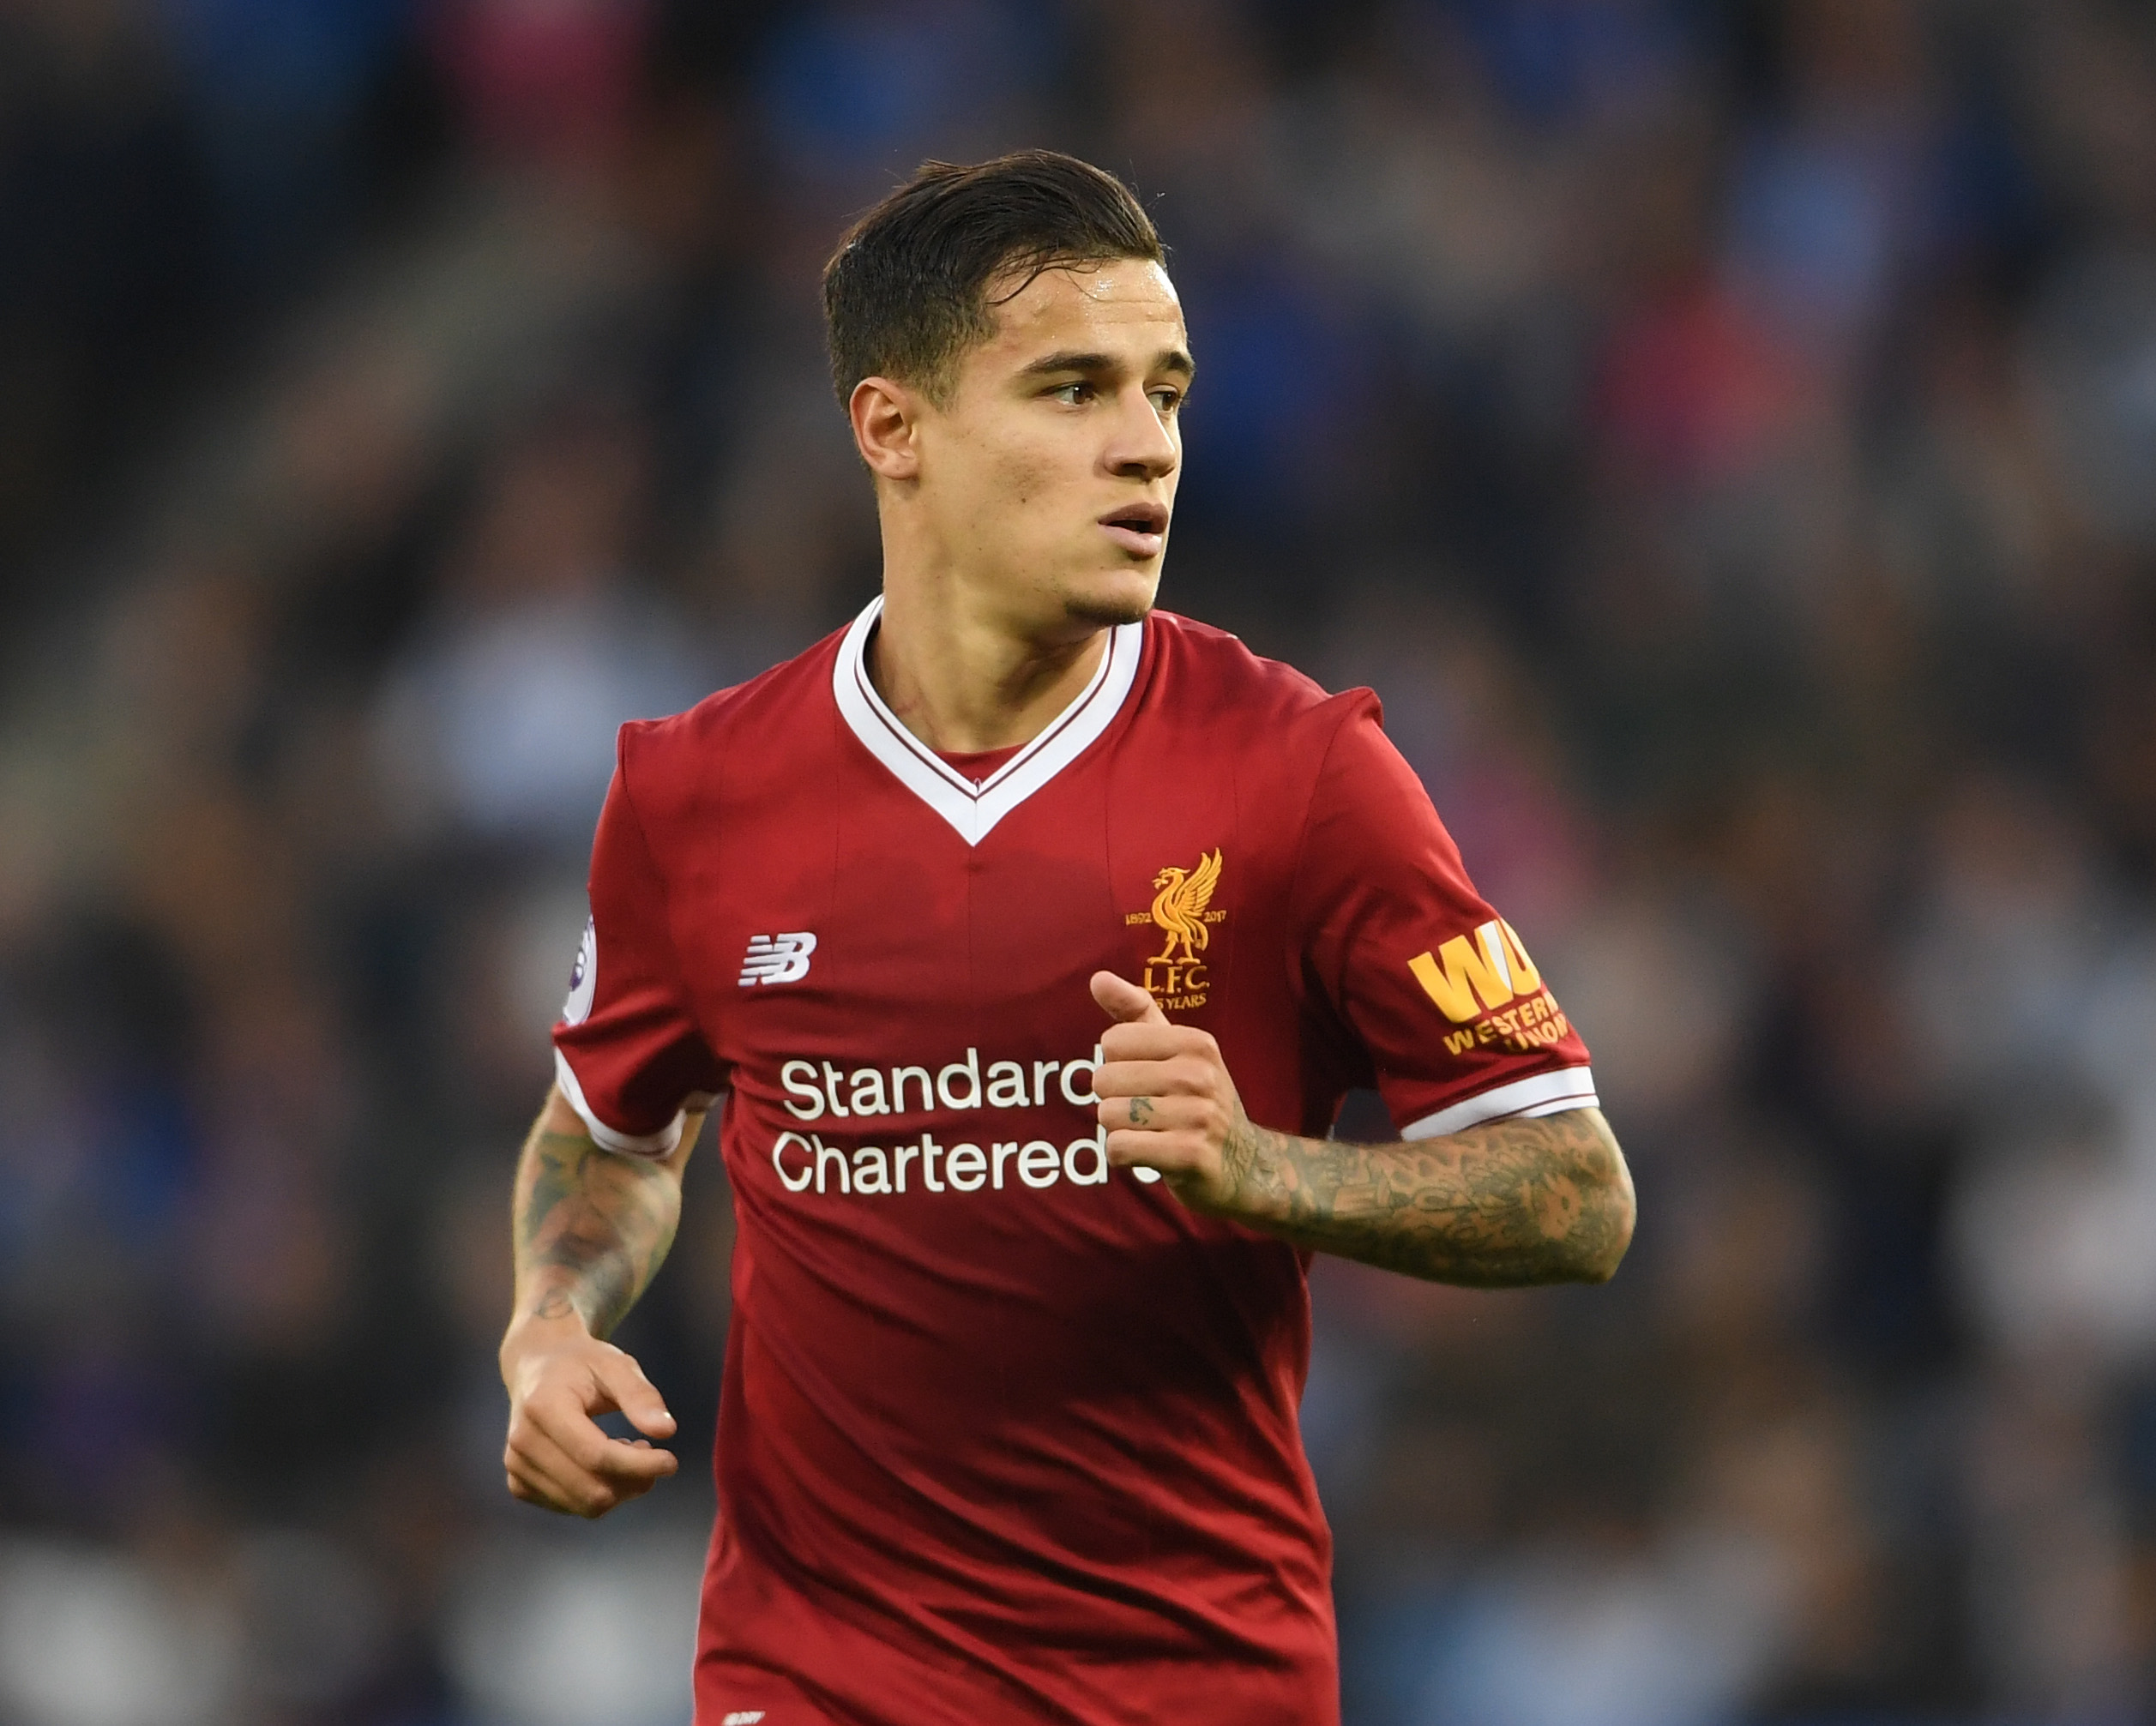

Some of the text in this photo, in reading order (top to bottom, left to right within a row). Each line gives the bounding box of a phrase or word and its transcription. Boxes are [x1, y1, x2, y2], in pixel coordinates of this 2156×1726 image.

[1203, 910, 1227, 923] 2017
[1165, 992, 1207, 1011] YEARS
[780, 1043, 1106, 1122] Standard
[772, 1123, 1109, 1194] Chartered
